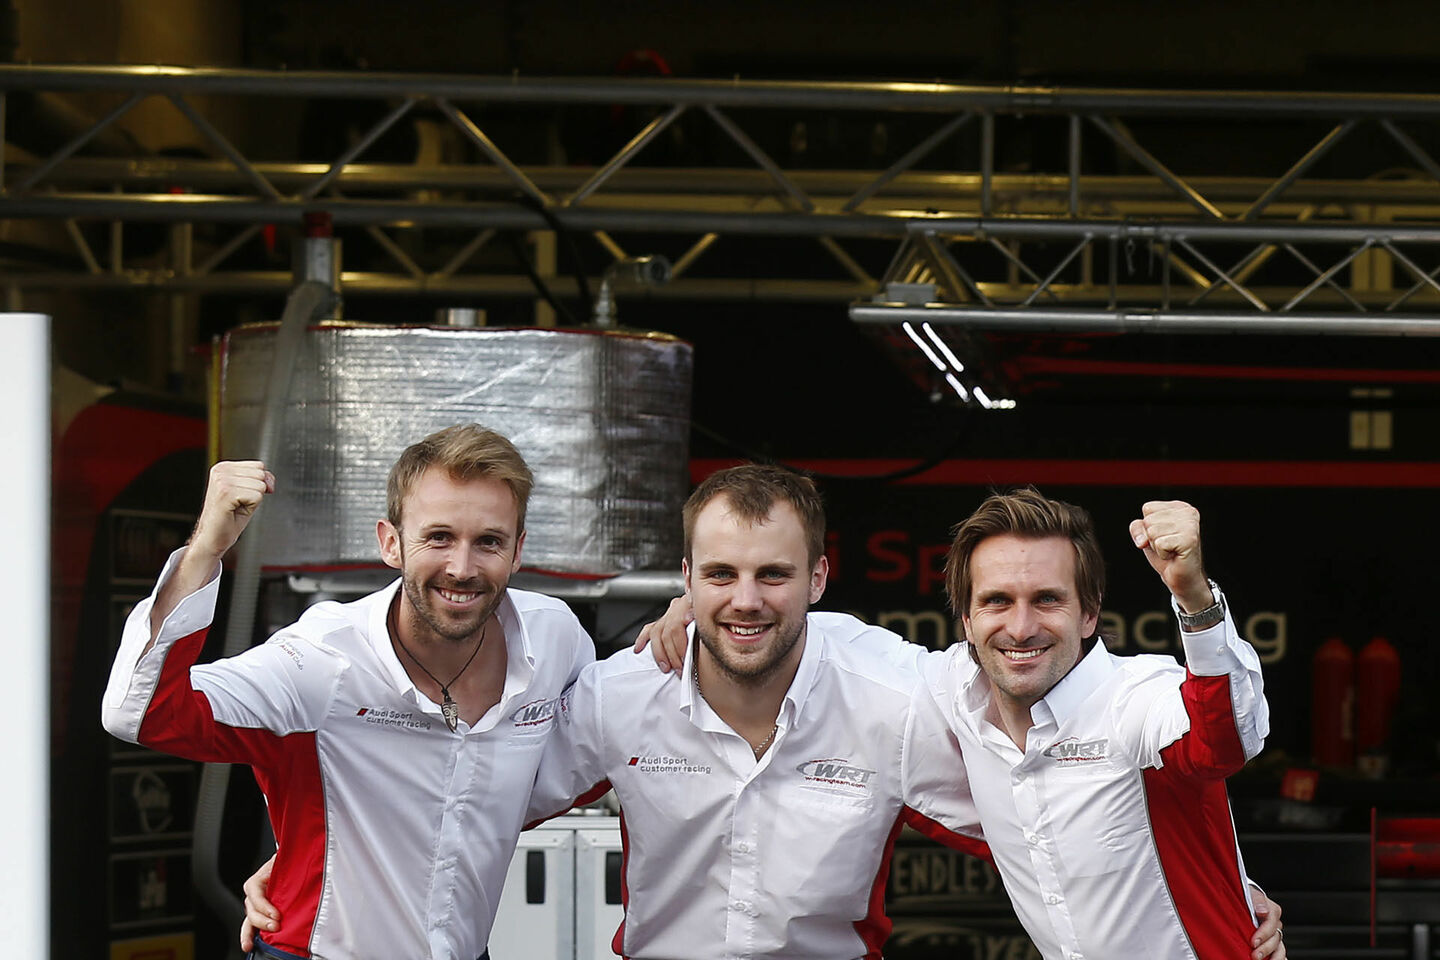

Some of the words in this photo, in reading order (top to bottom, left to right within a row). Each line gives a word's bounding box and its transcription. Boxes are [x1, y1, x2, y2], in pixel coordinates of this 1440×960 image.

[368, 708, 388, 717] Audi
[389, 710, 413, 720] Sport
[366, 716, 405, 727] customer
[406, 720, 432, 730] racing
[640, 757, 662, 765] Audi
[662, 757, 688, 766] Sport
[640, 765, 681, 773] customer
[683, 765, 712, 774] racing
[813, 763, 879, 783] WRT
[892, 853, 1000, 894] ENDLES
